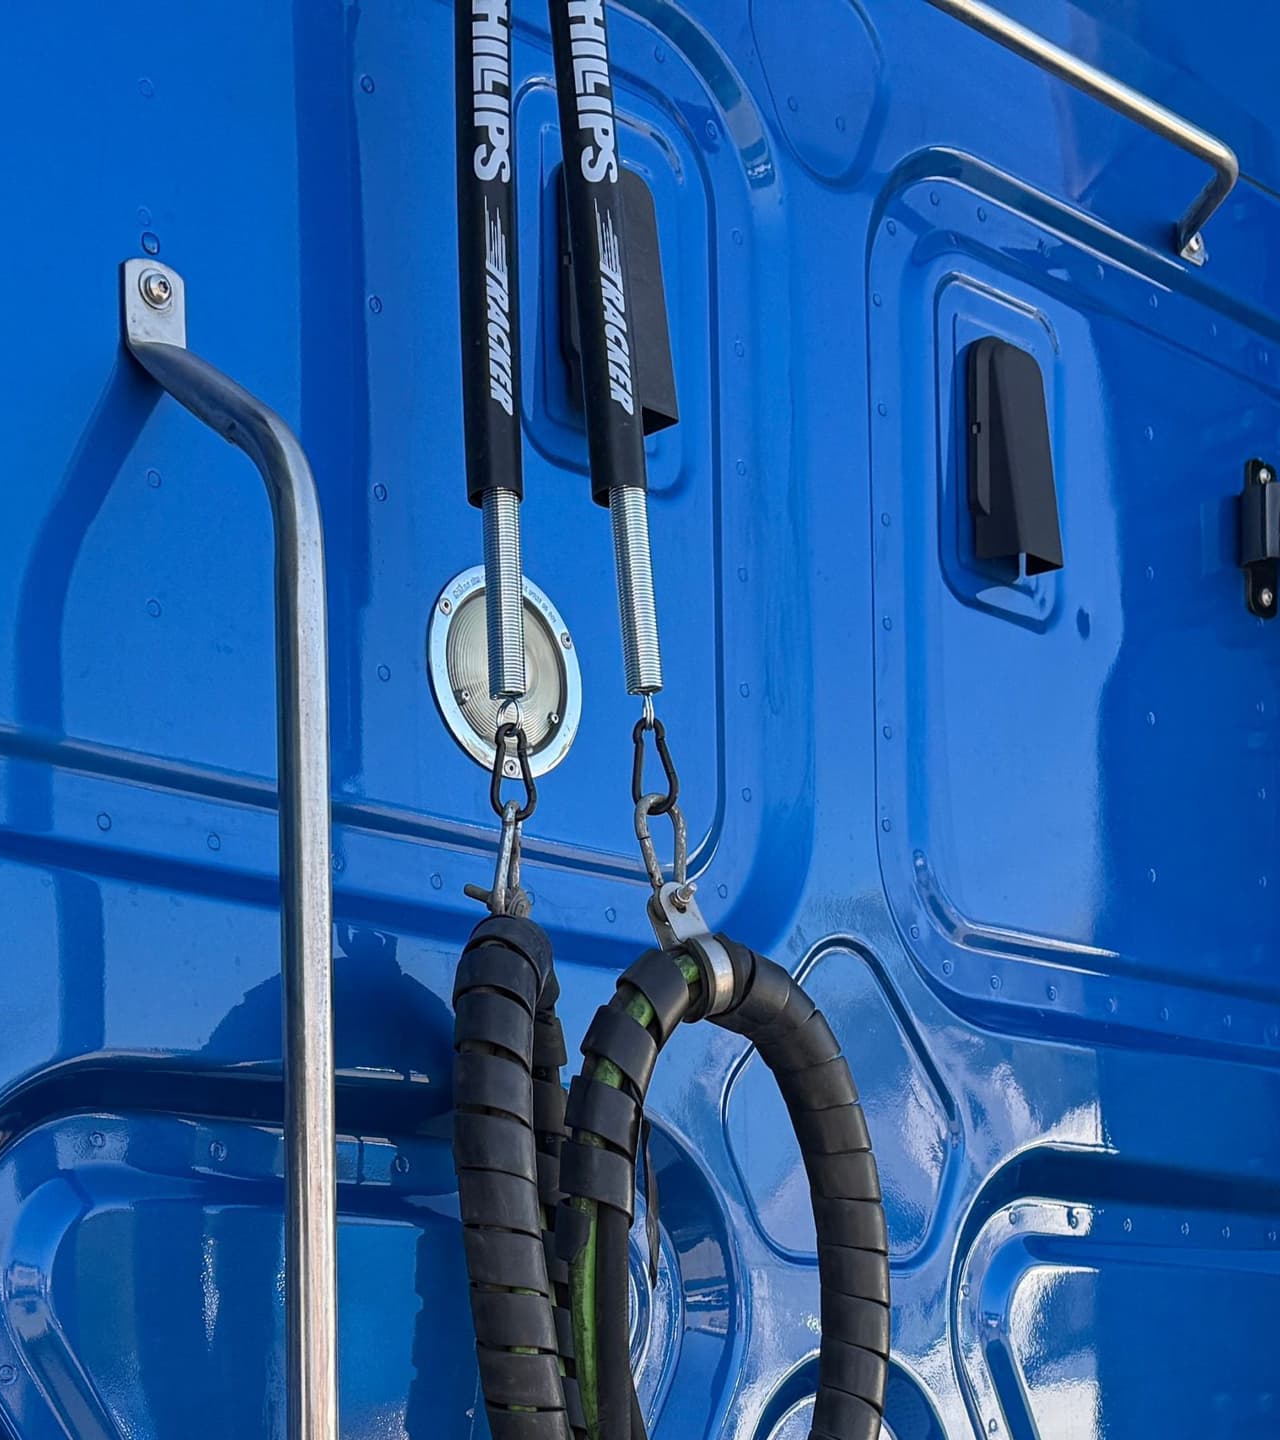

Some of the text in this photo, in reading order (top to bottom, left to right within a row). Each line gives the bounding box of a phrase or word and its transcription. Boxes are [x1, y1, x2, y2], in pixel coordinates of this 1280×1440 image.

[472, 0, 513, 416] HILLIPS TRACKER
[568, 0, 634, 416] HILLIPS TRACKER
